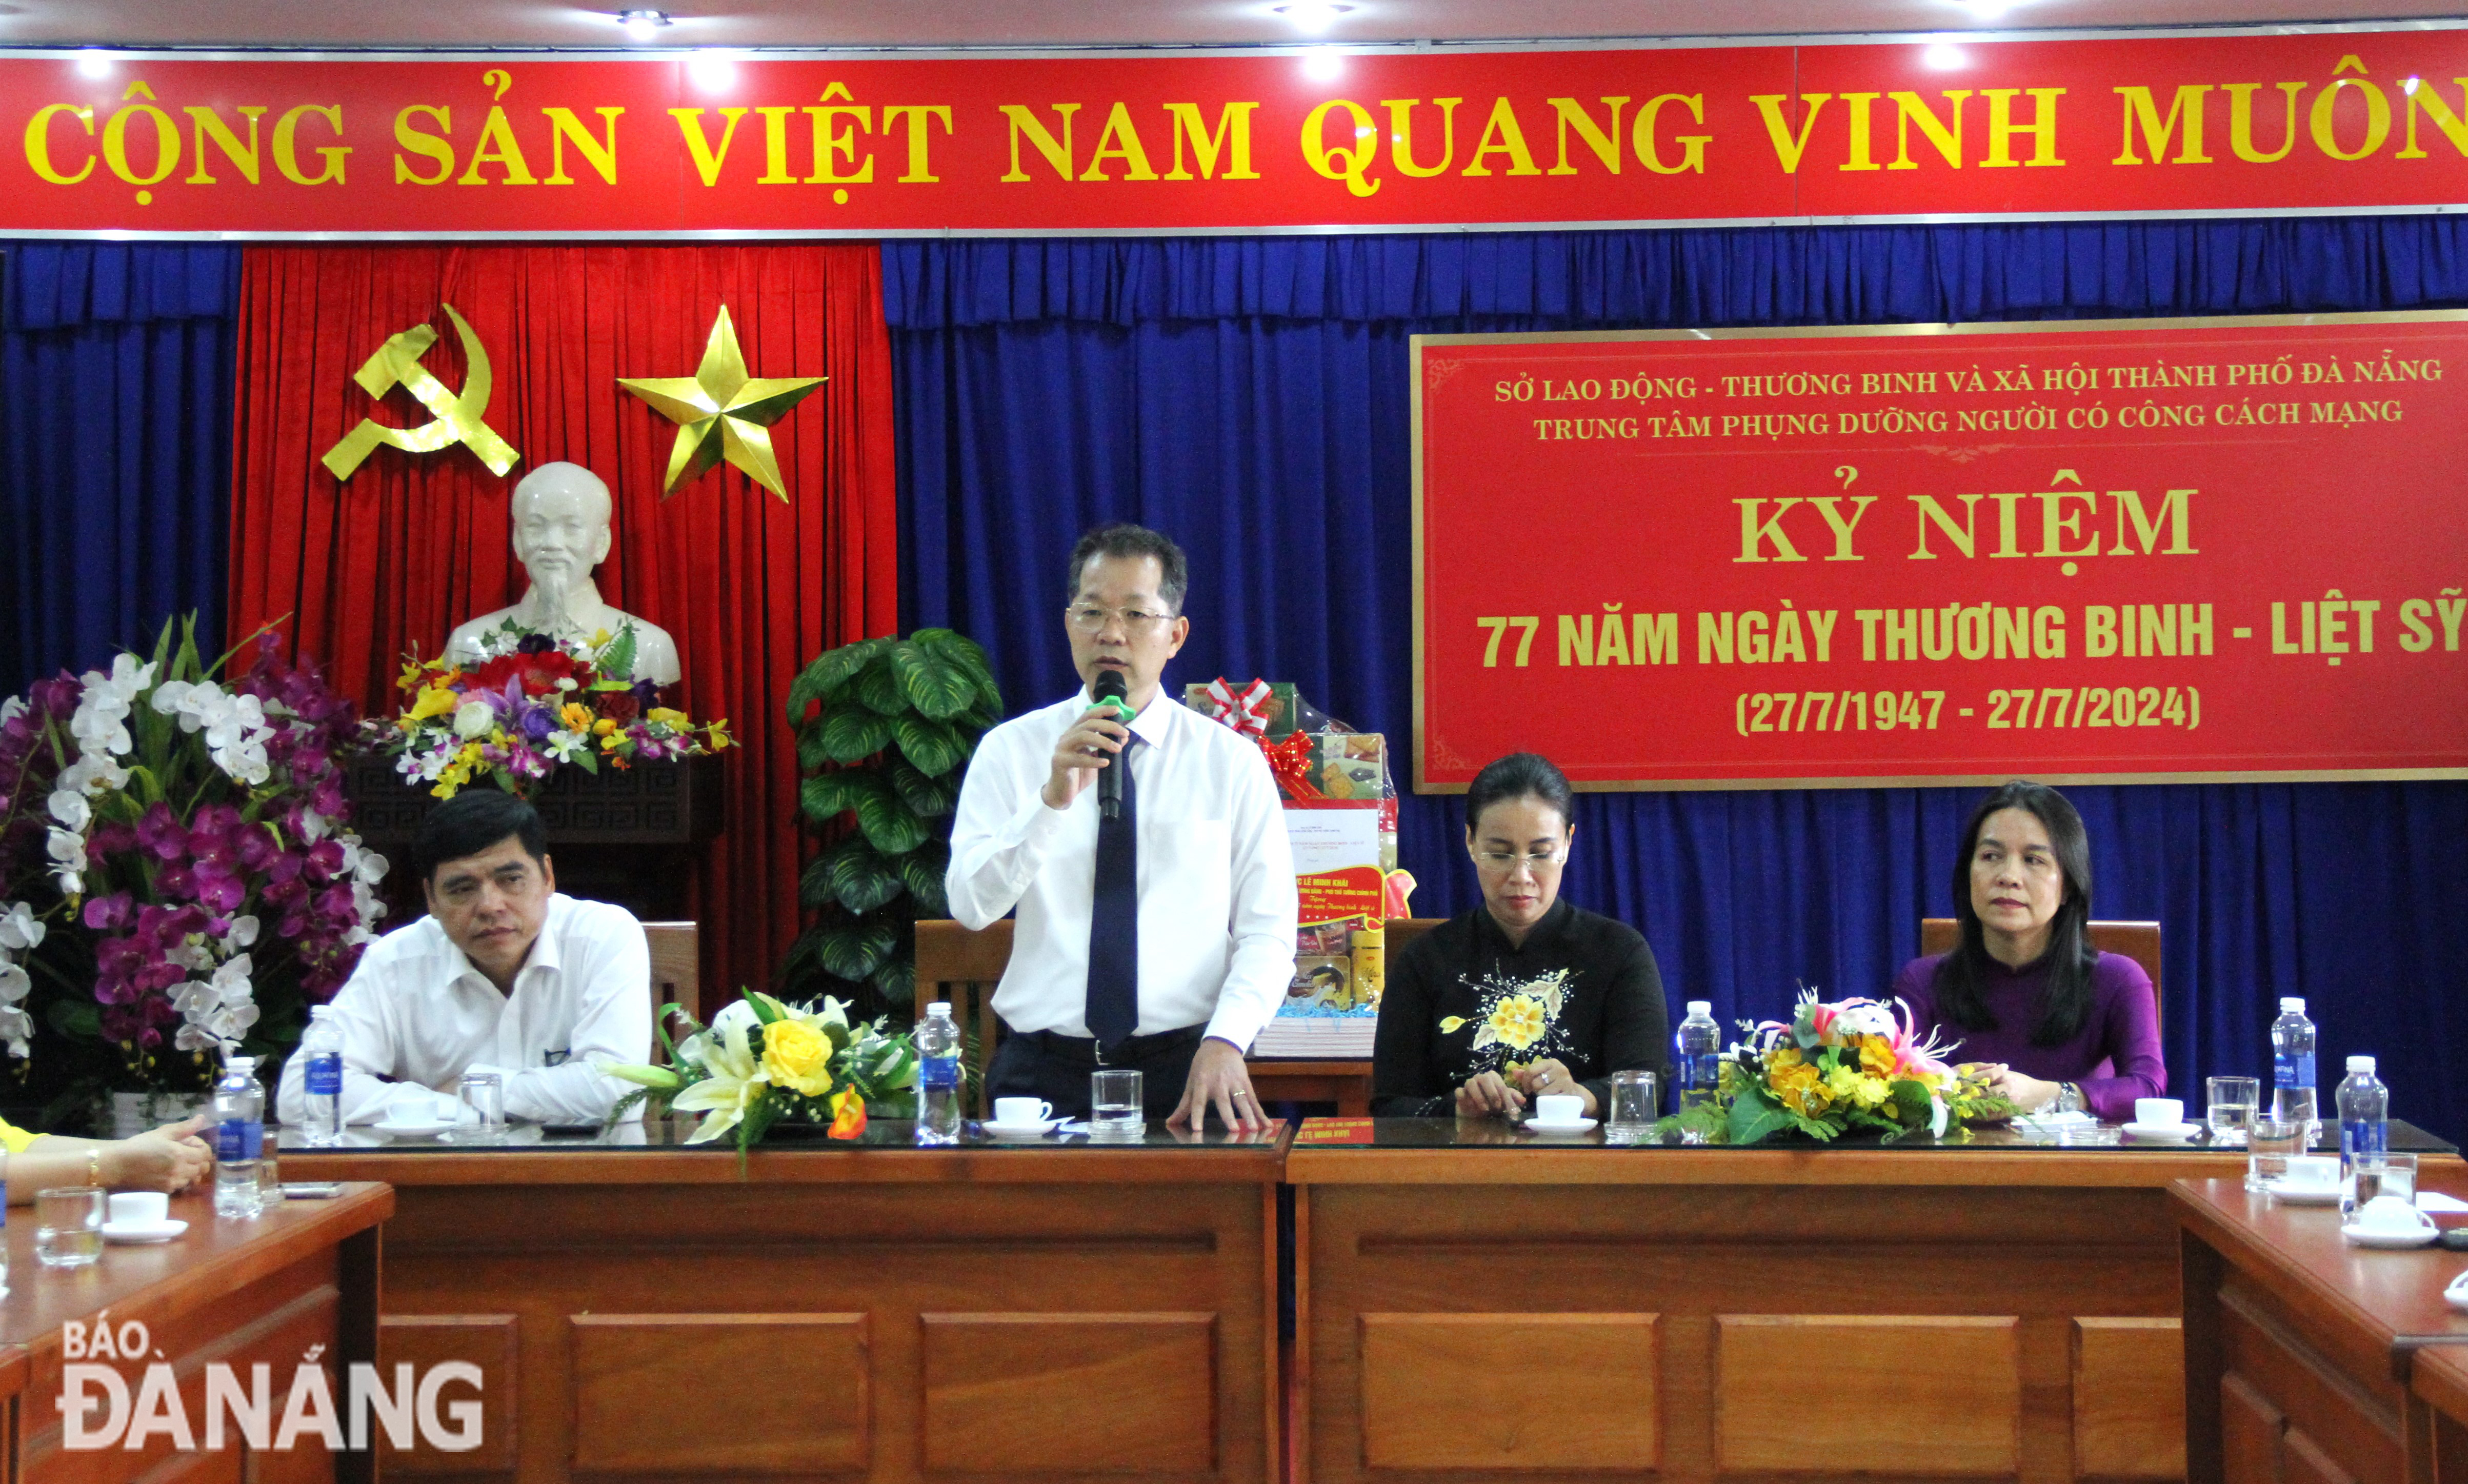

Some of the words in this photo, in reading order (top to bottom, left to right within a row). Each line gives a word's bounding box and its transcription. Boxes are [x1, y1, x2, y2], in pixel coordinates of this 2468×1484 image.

[24, 80, 353, 205] CỘNG
[394, 70, 625, 185] SẢN
[667, 82, 953, 205] VIỆT
[999, 102, 1261, 183] NAM
[1300, 93, 1713, 197] QUANG
[1749, 88, 2067, 174] VINH
[2112, 55, 2468, 165] MUÔN
[1495, 372, 1534, 402] SỞ
[1543, 379, 1601, 401] LAO
[1610, 372, 1696, 405] ĐỘNG
[1721, 372, 1852, 397] THƯƠNG
[1861, 372, 1937, 394] BINH
[1946, 365, 1987, 393] VÀ
[1993, 364, 2034, 392] XÃ
[2043, 362, 2099, 395] HỘI
[2108, 359, 2216, 388] THÀNH
[2227, 354, 2293, 386] PHỐ
[2301, 355, 2345, 384] ĐÀ
[2353, 349, 2442, 382] NẴNG
[1534, 418, 1639, 440] TRUNG
[1648, 410, 1712, 437] TÂM
[1722, 414, 1829, 440] PHỤNG
[1839, 407, 1949, 434] DƯỠNG
[1957, 401, 2057, 432] NGƯỜI
[2066, 400, 2109, 429] CÓ
[2118, 399, 2205, 428] CÔNG
[2215, 397, 2301, 425] CÁCH
[2310, 400, 2403, 428] MẠNG
[1732, 465, 1878, 563] KỶ
[1908, 469, 2199, 576] NIỆM
[1477, 616, 1539, 667] 77
[1558, 603, 1678, 666] NĂM
[1698, 599, 1838, 664] NGÀY
[1855, 602, 2066, 661] THƯƠNG
[2085, 603, 2213, 658] BINH
[2233, 627, 2252, 638] -
[2272, 589, 2381, 666] LIỆT
[2399, 588, 2467, 653] SỸ
[1736, 690, 1946, 737] (27/7/1947
[1959, 708, 1974, 716] -
[1987, 686, 2200, 730] 27/7/2024)
